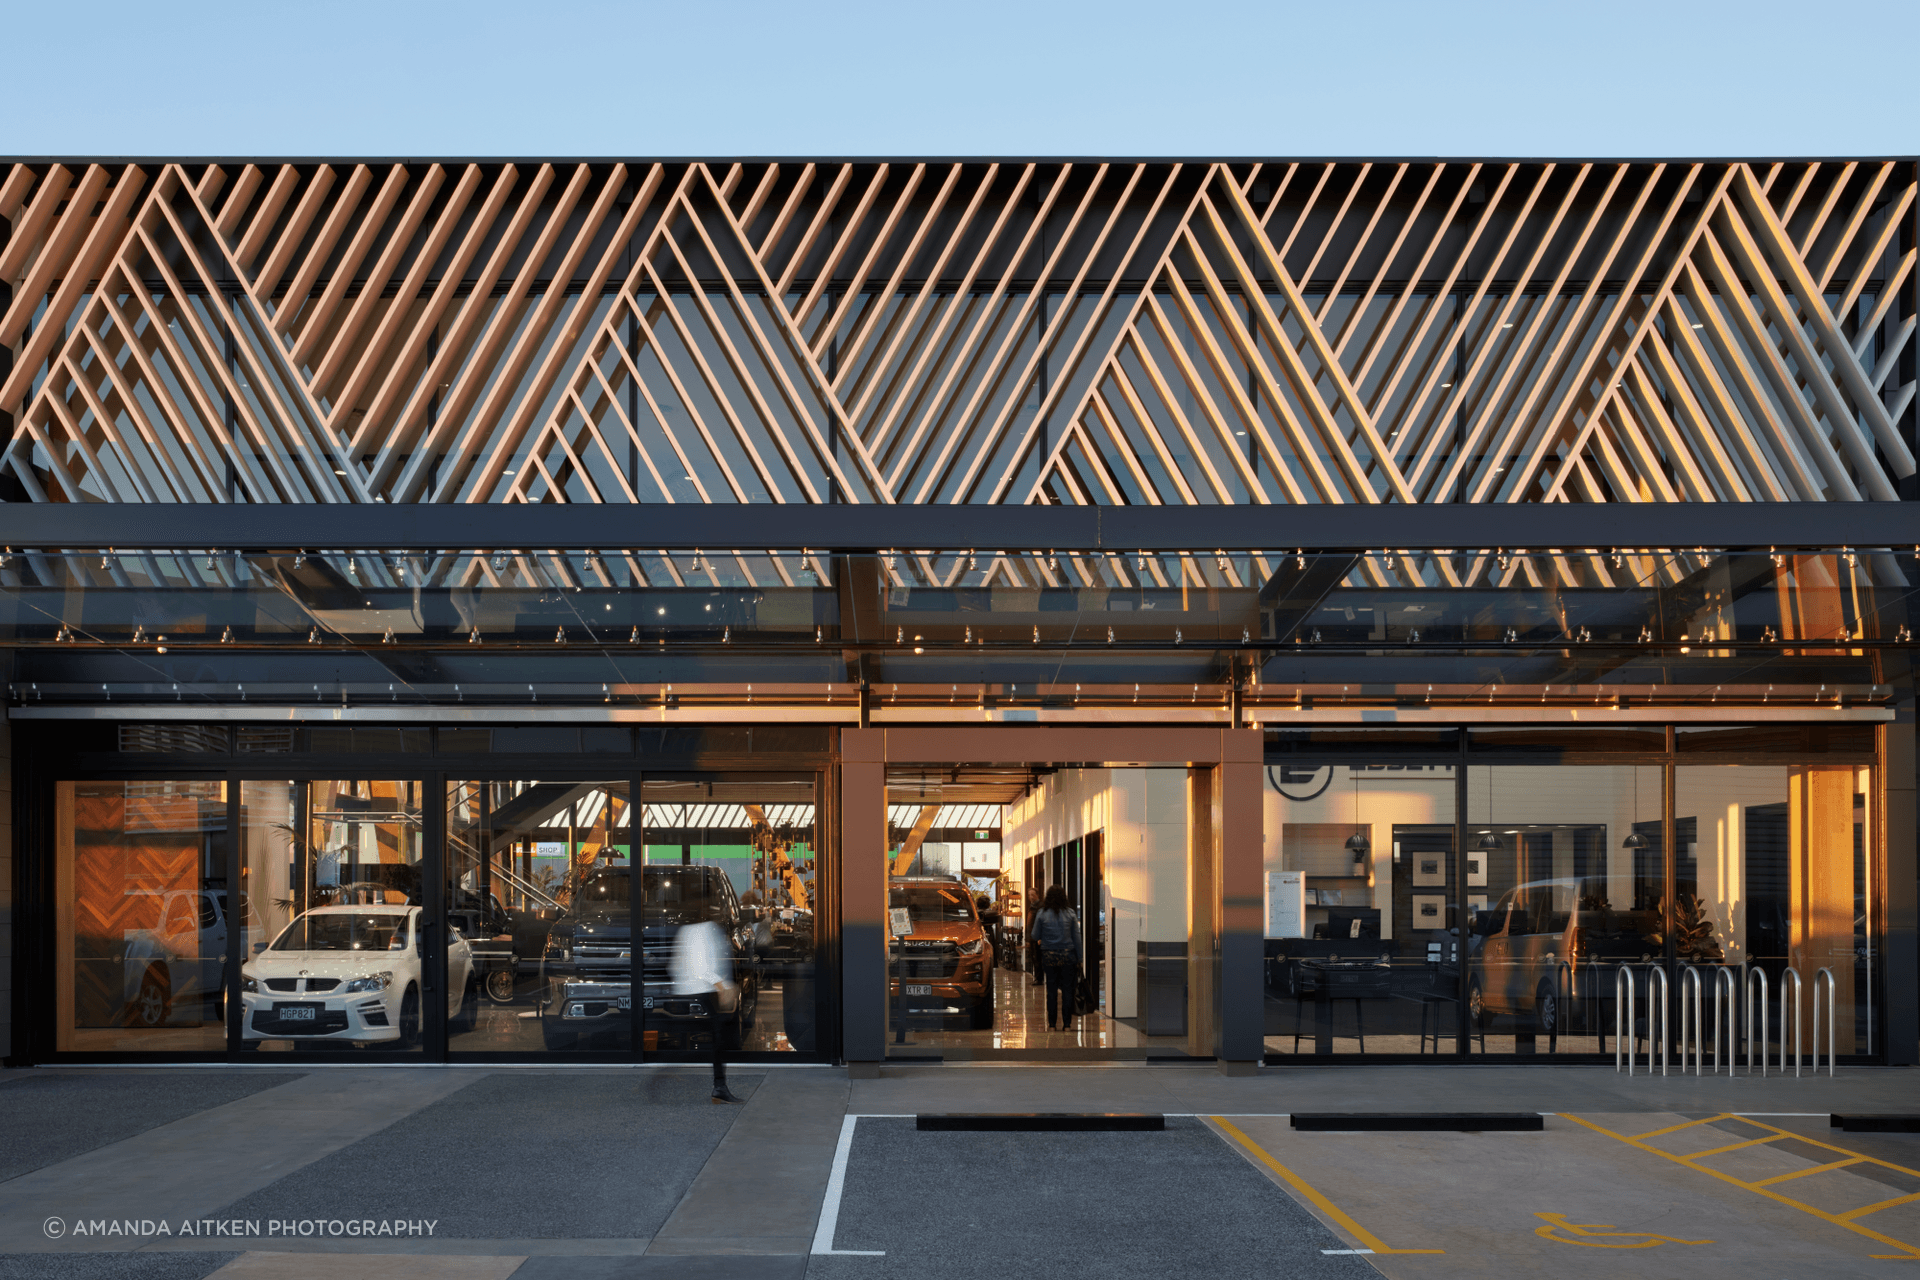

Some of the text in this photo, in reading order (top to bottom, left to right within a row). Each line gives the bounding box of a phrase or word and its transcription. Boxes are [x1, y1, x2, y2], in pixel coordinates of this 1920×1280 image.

[907, 986, 922, 994] XTR
[618, 998, 653, 1007] NM22
[280, 1009, 314, 1018] HGP821
